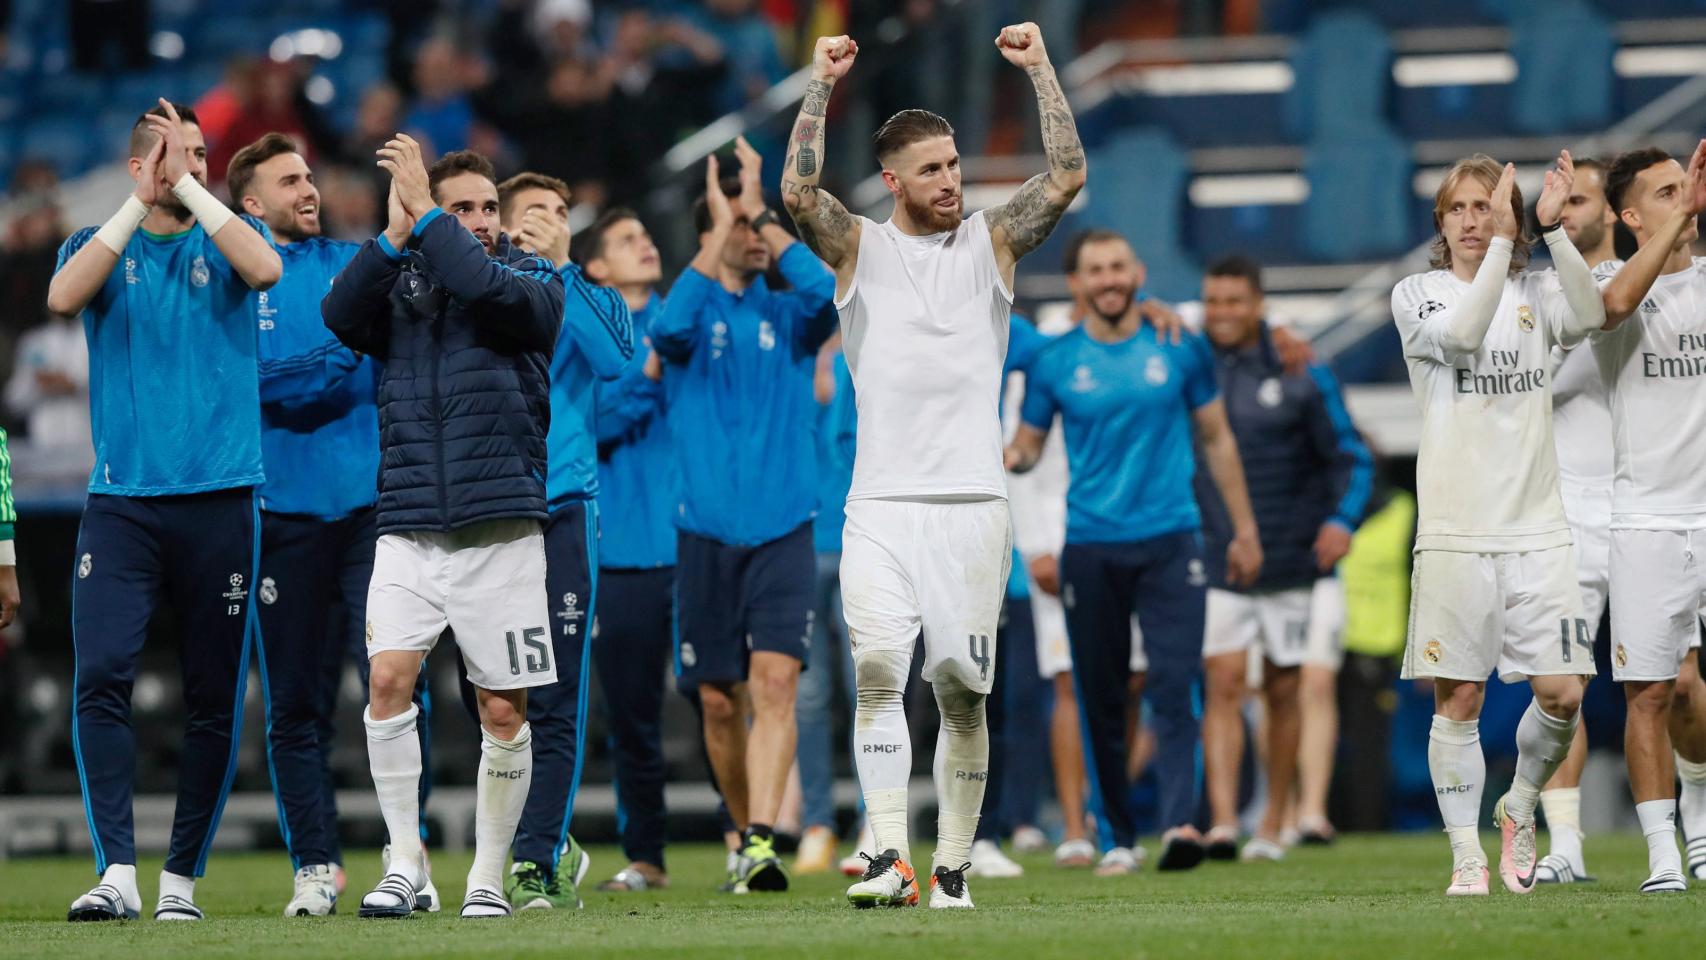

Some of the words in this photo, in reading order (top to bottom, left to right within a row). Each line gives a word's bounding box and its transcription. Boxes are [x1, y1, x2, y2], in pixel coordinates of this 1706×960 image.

[1491, 350, 1519, 368] Fly
[1642, 352, 1706, 378] Emir
[227, 604, 240, 616] 13
[563, 623, 577, 635] 16
[506, 627, 550, 675] 15
[969, 634, 991, 681] 4
[863, 744, 903, 754] RMCF
[487, 768, 526, 780] RMCF
[1437, 783, 1474, 795] RMCF
